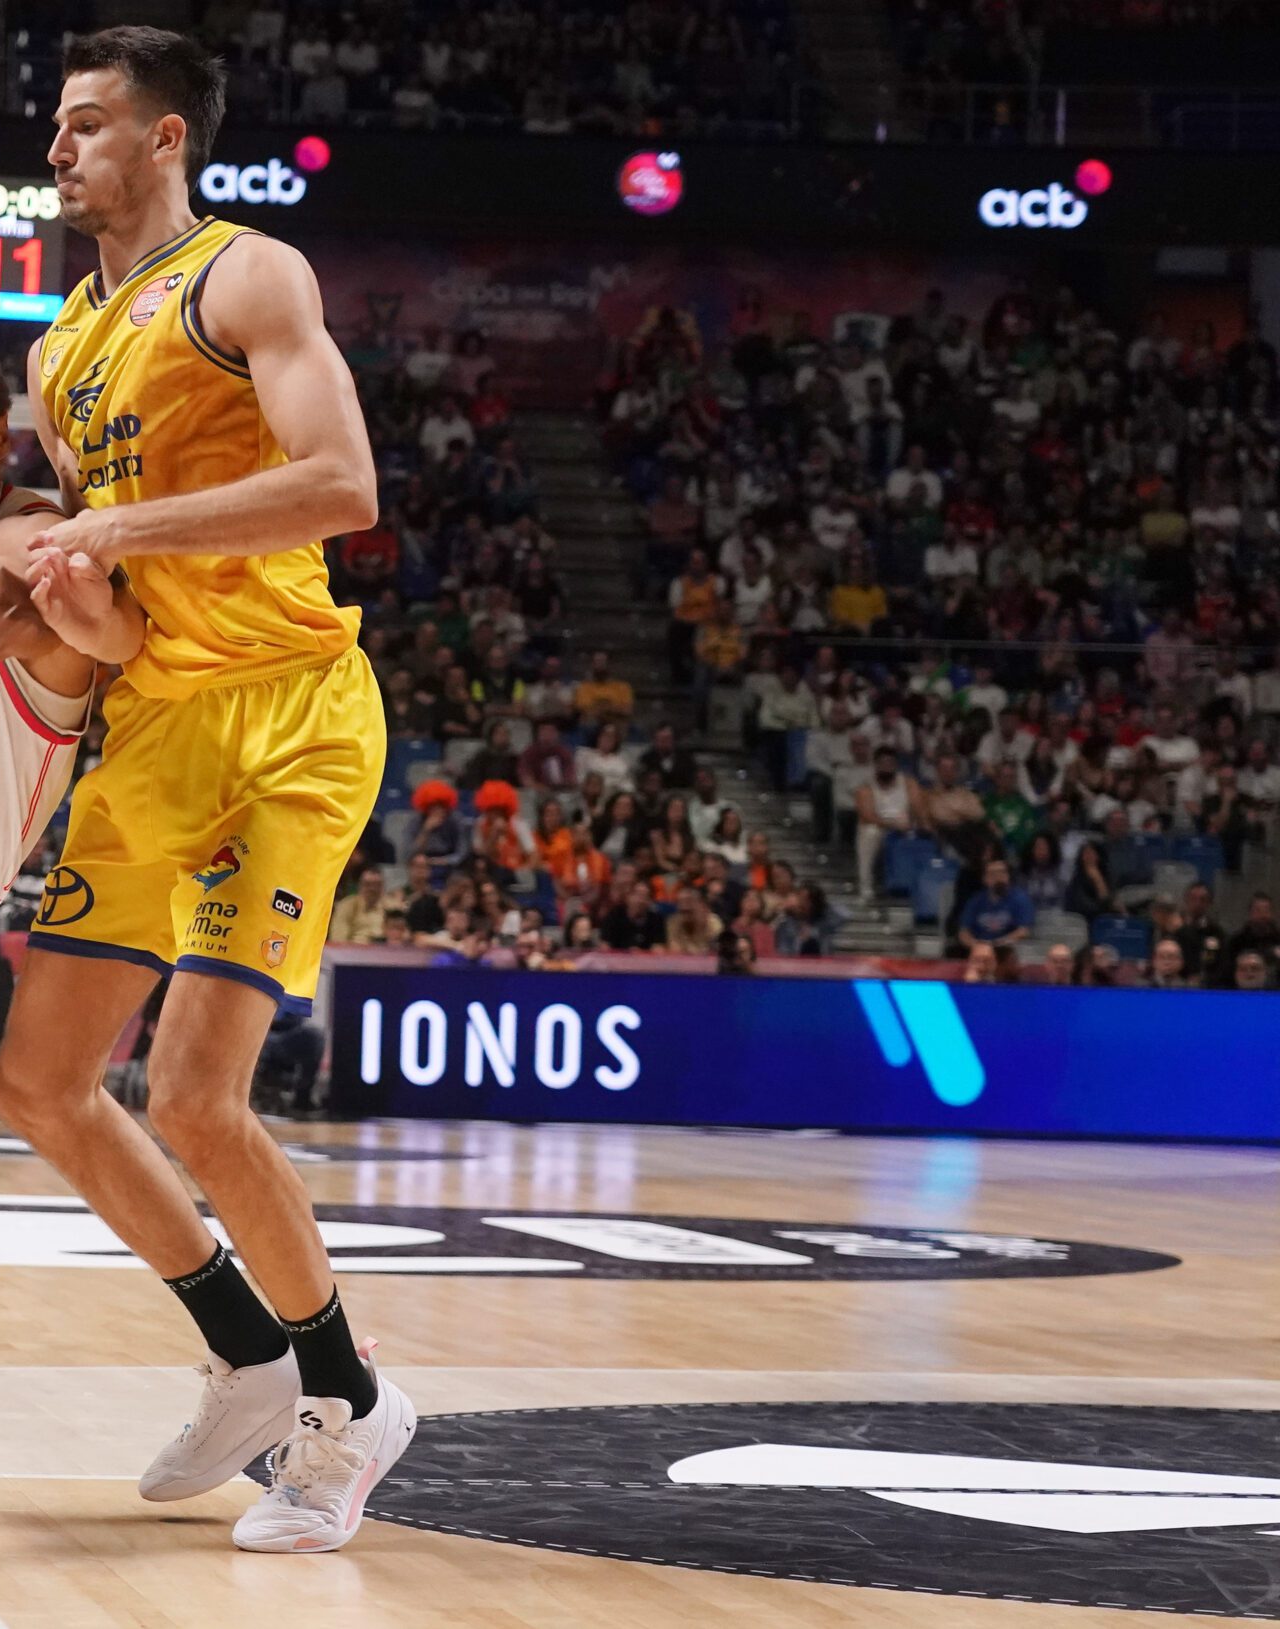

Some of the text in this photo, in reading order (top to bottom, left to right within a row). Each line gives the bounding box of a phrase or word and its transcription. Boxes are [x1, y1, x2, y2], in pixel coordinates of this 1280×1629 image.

[199, 158, 306, 205] acb
[978, 183, 1087, 228] acb
[275, 900, 296, 915] acb
[360, 998, 641, 1091] IONOS
